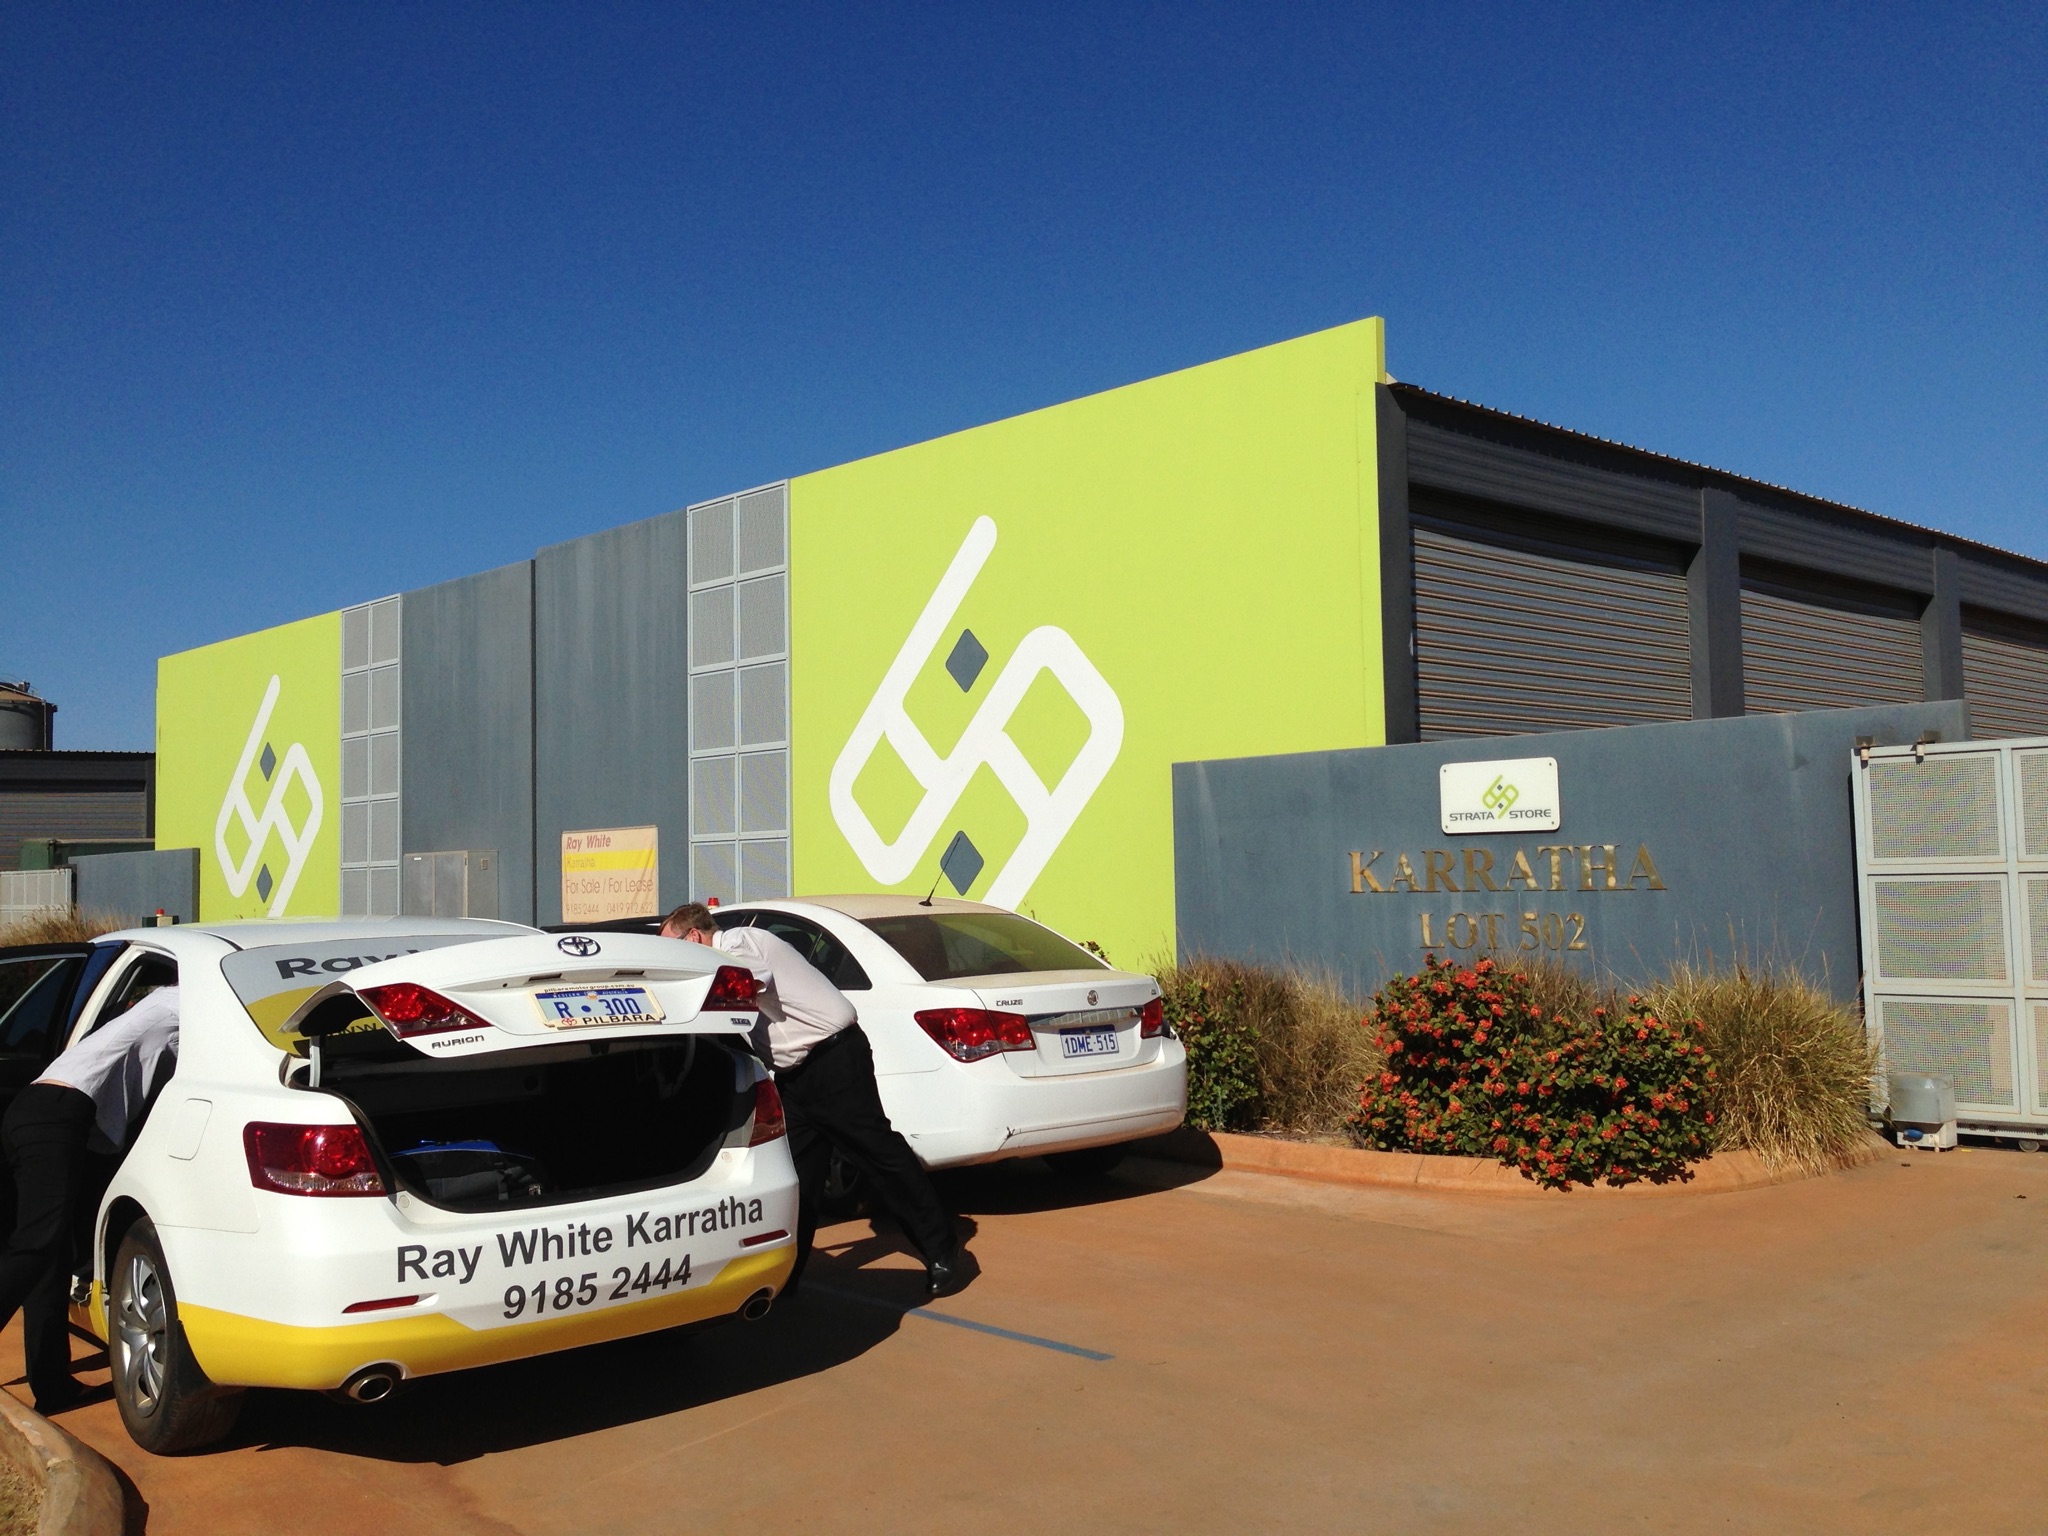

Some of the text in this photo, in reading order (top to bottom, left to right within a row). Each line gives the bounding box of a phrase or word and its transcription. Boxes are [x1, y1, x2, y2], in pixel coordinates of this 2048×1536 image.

[1449, 808, 1552, 822] STRATA STORE
[566, 834, 612, 852] Ray White
[1348, 843, 1668, 893] KARRATHA
[565, 879, 579, 894] For
[581, 878, 601, 894] Sale
[608, 877, 623, 893] For
[625, 877, 654, 893] Lease
[583, 903, 600, 915] 2444
[606, 902, 624, 915] 0419
[1419, 911, 1588, 950] LOT 502
[553, 997, 643, 1019] R 300
[995, 998, 1024, 1007] CRUZE
[583, 1013, 657, 1025] PILBARA
[431, 1034, 485, 1050] AURION
[397, 1195, 764, 1285] Ray White Karratha
[503, 1253, 693, 1320] 9185 2444
